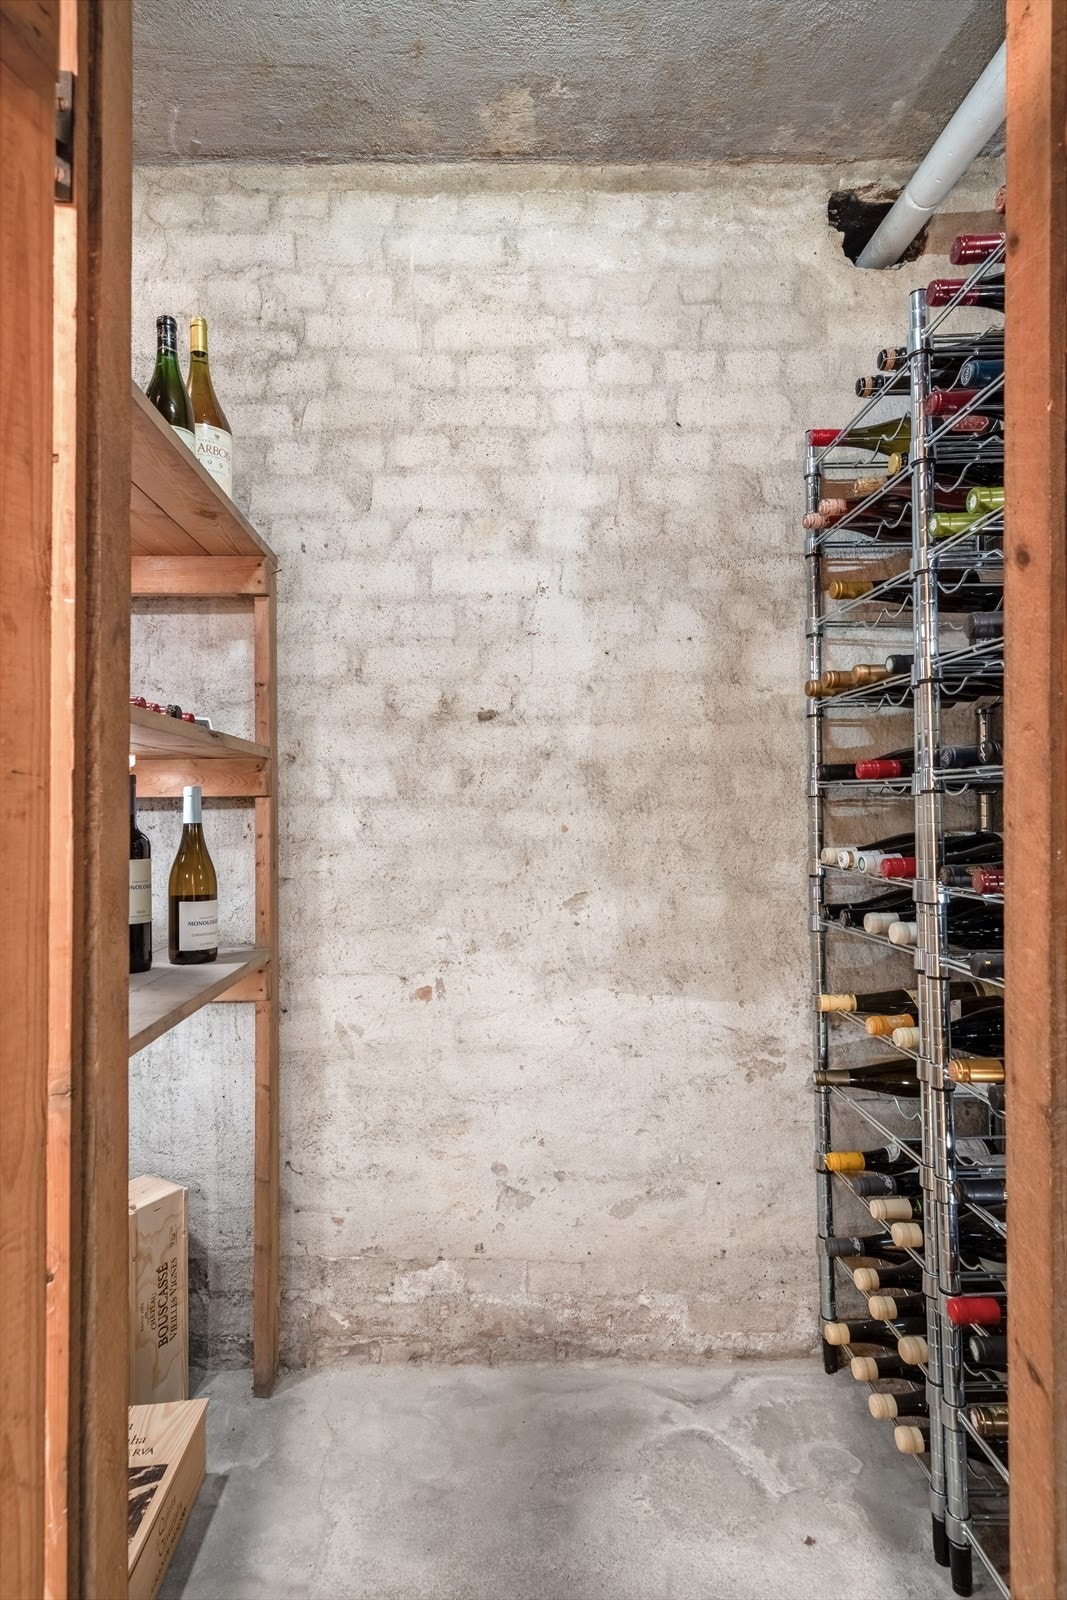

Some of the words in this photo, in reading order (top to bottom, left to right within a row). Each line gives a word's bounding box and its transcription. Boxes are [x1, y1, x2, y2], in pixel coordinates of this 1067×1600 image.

[169, 1257, 178, 1297] VIGNES
[157, 1262, 169, 1349] BOUSCASSÉ
[169, 1296, 178, 1341] VIEILLES
